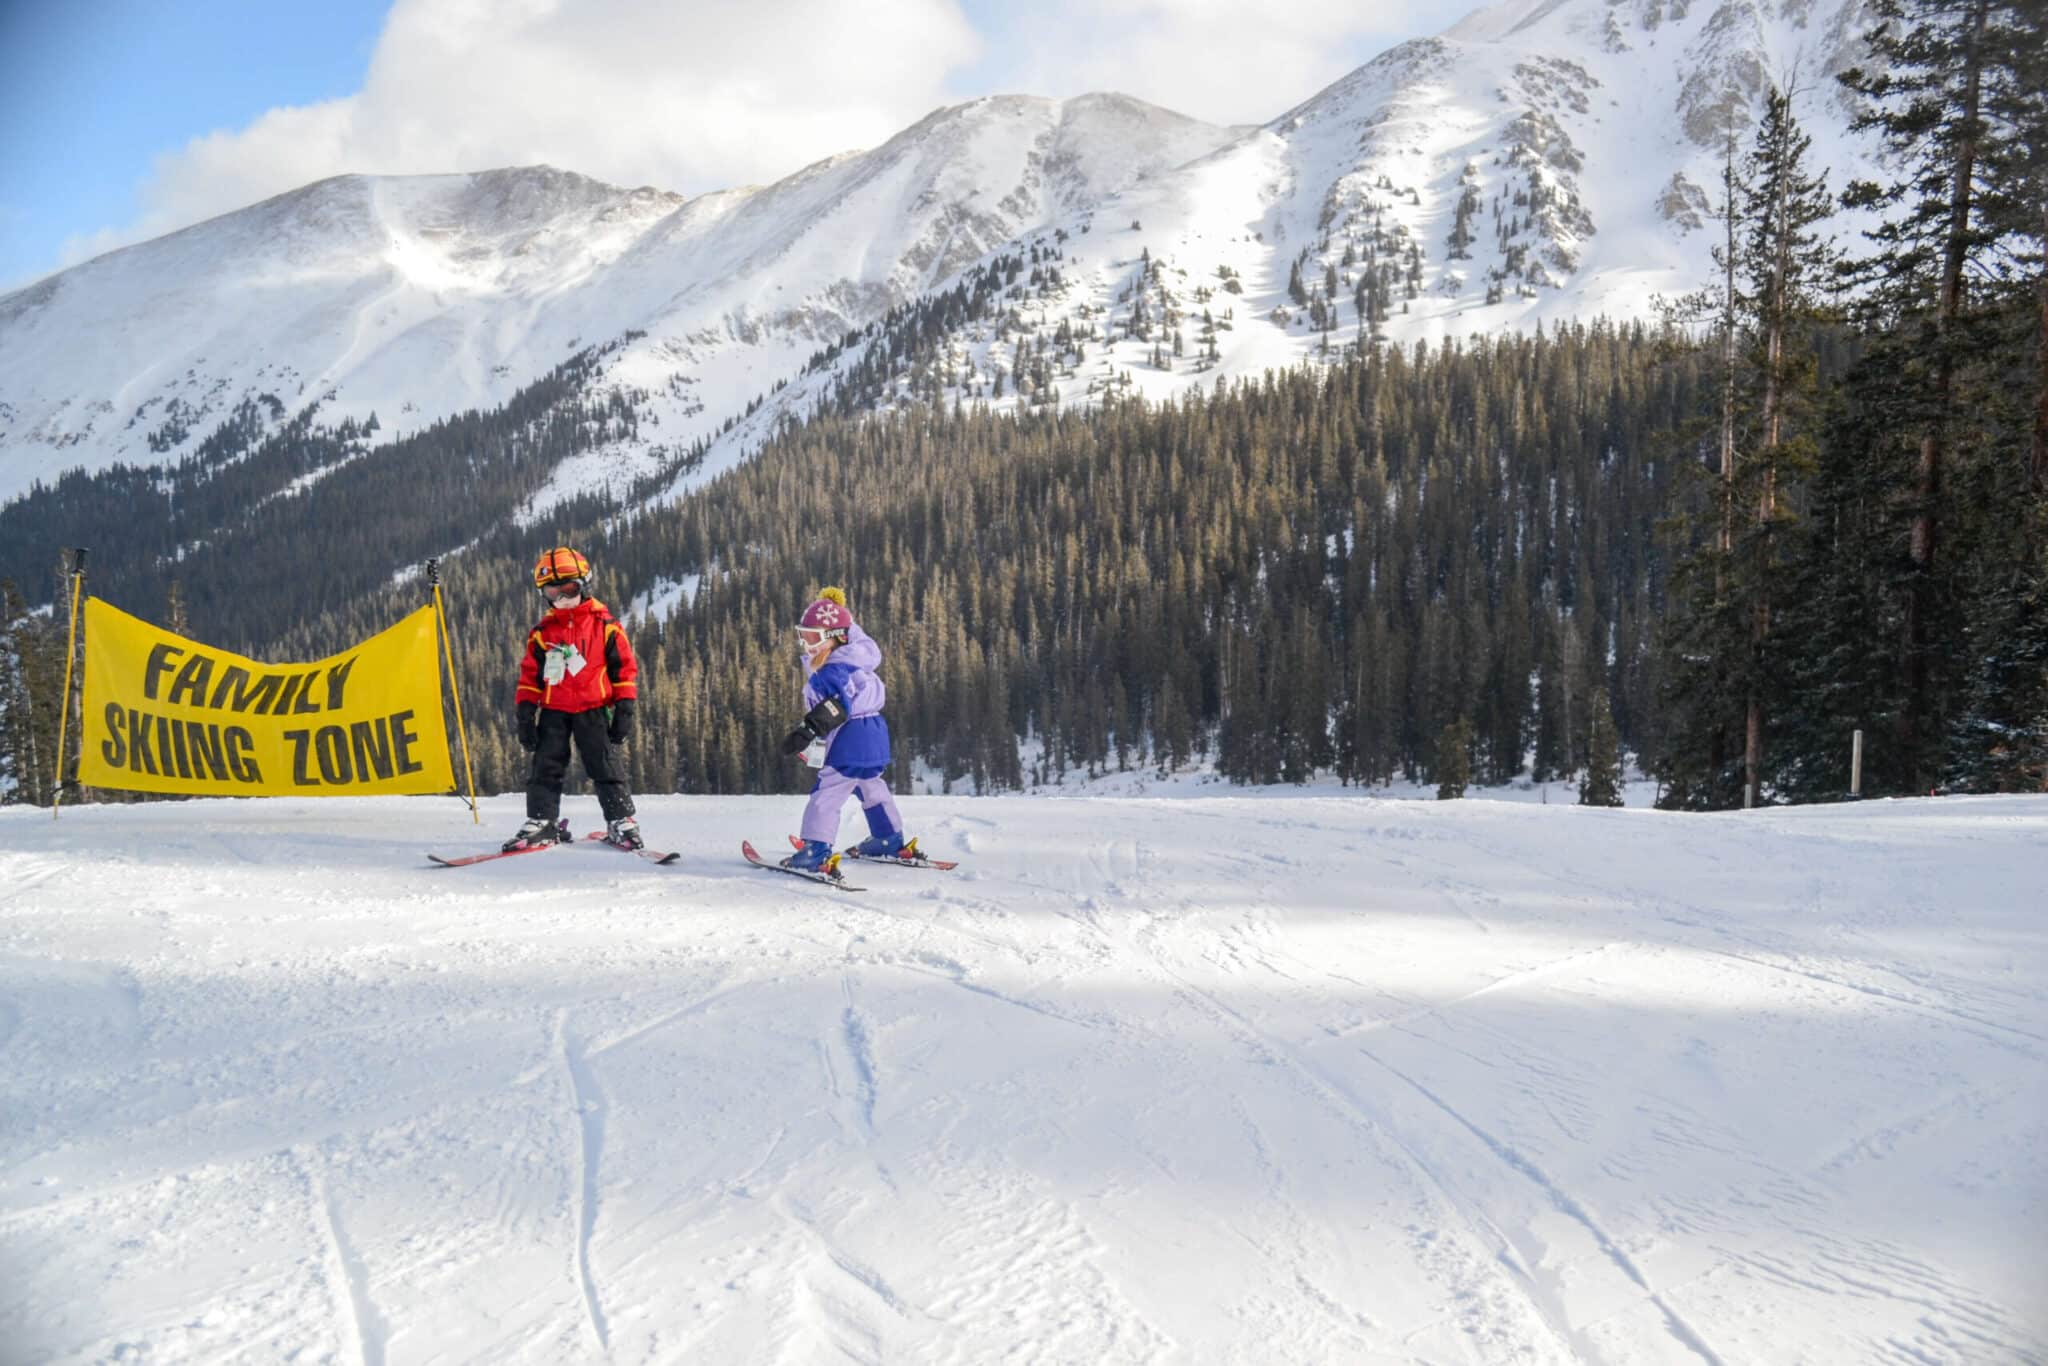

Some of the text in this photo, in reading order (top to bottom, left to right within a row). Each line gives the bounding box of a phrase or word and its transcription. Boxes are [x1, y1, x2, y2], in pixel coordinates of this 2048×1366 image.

[144, 643, 358, 715] FAMILY
[102, 702, 423, 786] SKIING ZONE
